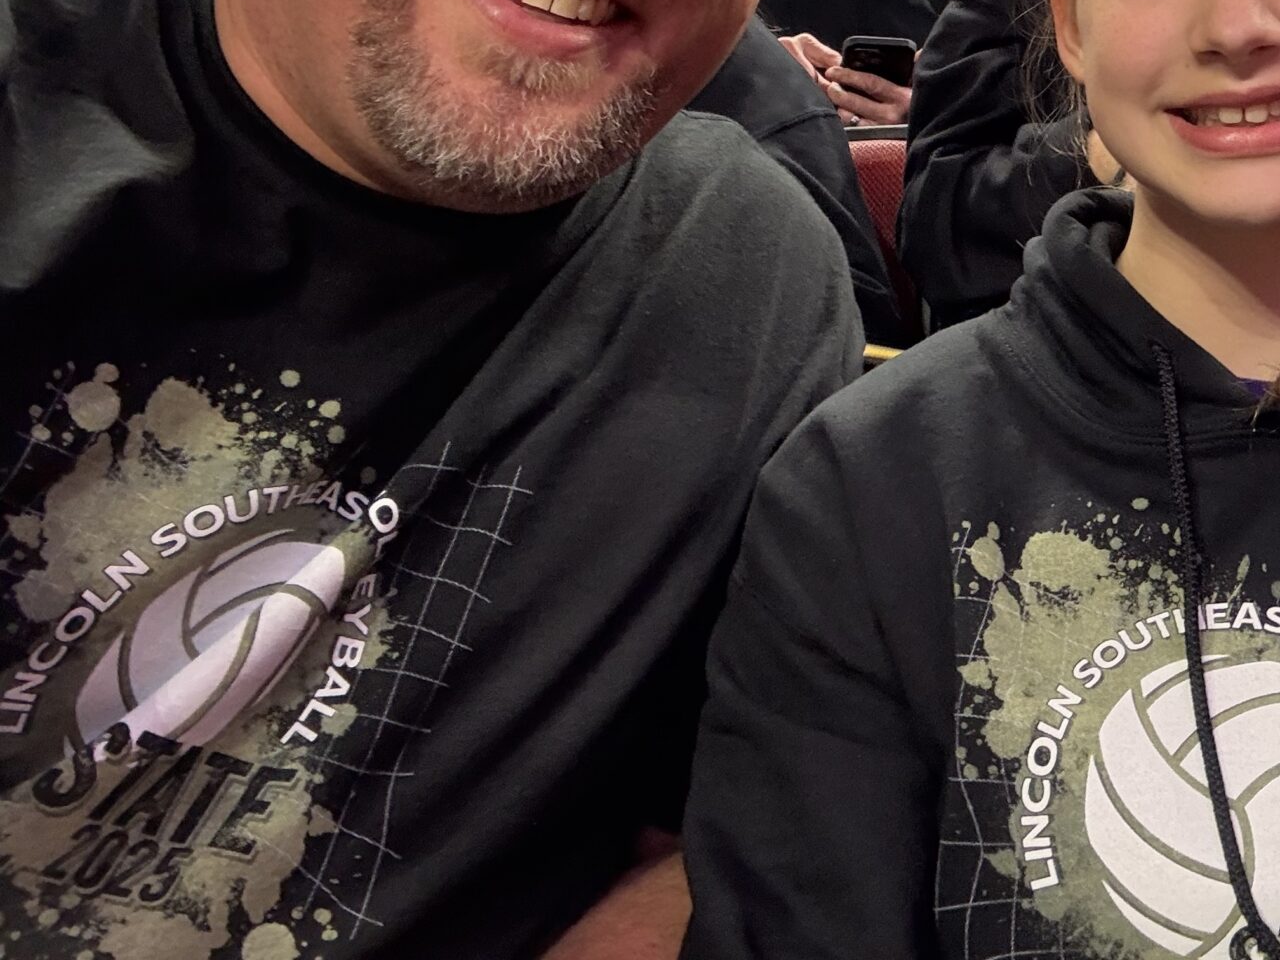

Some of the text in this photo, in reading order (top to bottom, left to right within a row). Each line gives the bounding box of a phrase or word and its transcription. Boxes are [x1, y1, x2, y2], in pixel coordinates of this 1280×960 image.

[0, 549, 151, 736] LINCOLN
[150, 479, 370, 559] SOUTHEAS
[31, 721, 300, 857] STATE
[41, 823, 195, 903] 2025
[1020, 684, 1083, 892] LINCOLN
